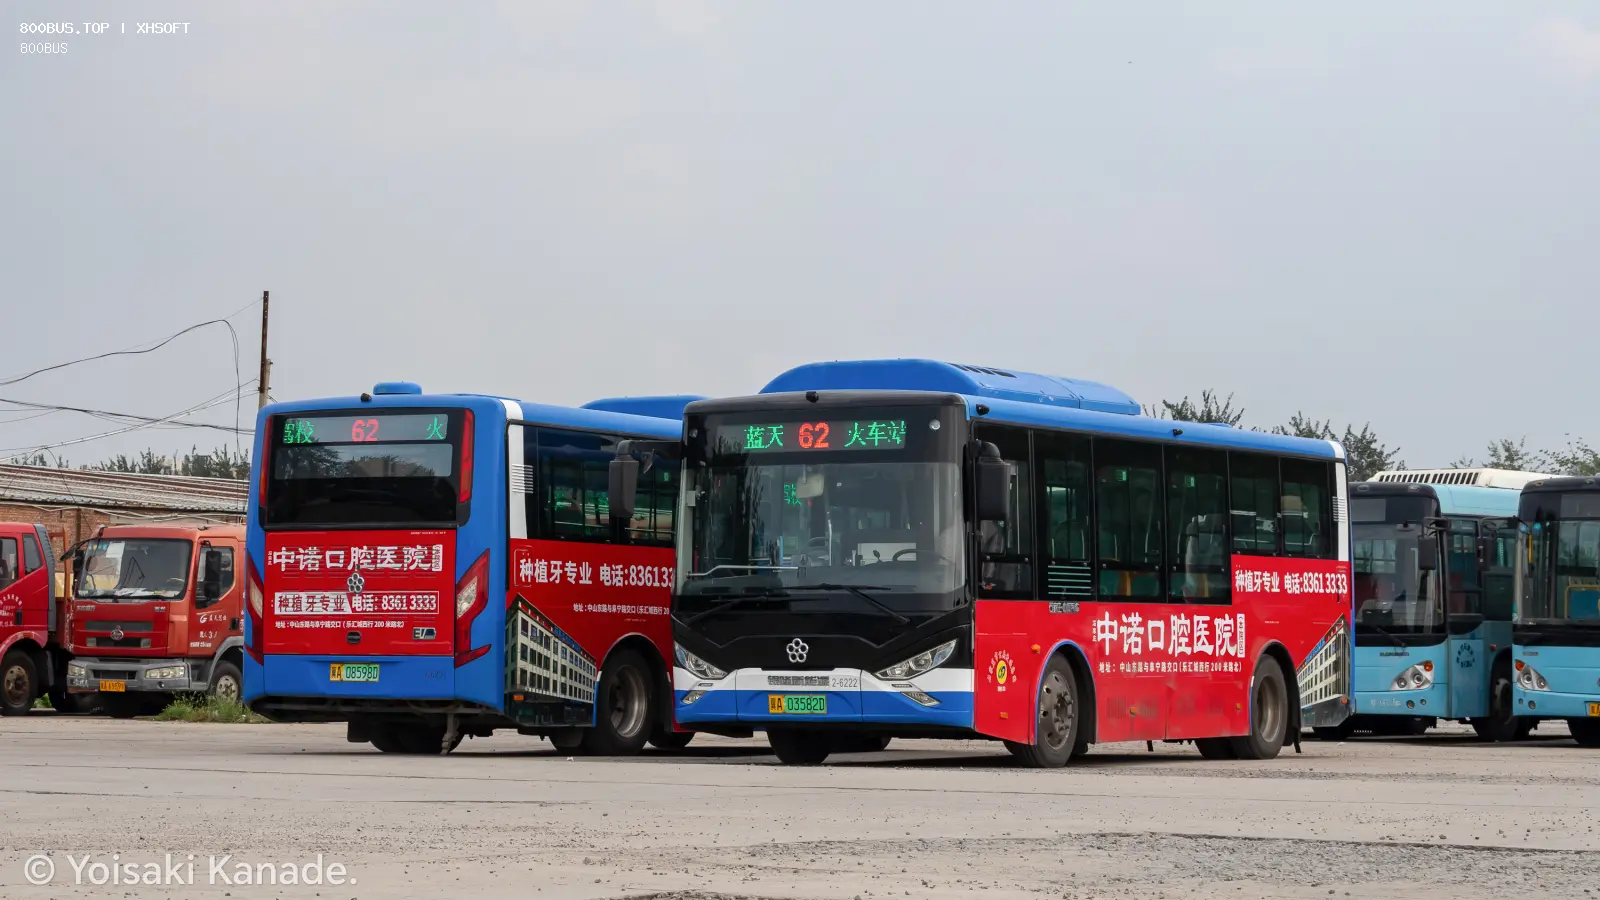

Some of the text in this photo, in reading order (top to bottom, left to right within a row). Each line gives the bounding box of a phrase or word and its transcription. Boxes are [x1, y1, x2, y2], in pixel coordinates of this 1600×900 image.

[351, 418, 379, 442] 62
[426, 416, 446, 440] 火
[743, 420, 907, 449] 蓝天 62 火车站
[273, 544, 433, 572] 中诺口腔医院
[519, 558, 593, 585] 种植牙专业
[1235, 569, 1280, 593] 种植牙专业
[278, 594, 346, 613] 种植牙专业
[1097, 610, 1237, 658] 中诺口腔医院
[831, 677, 858, 688] 2-6222
